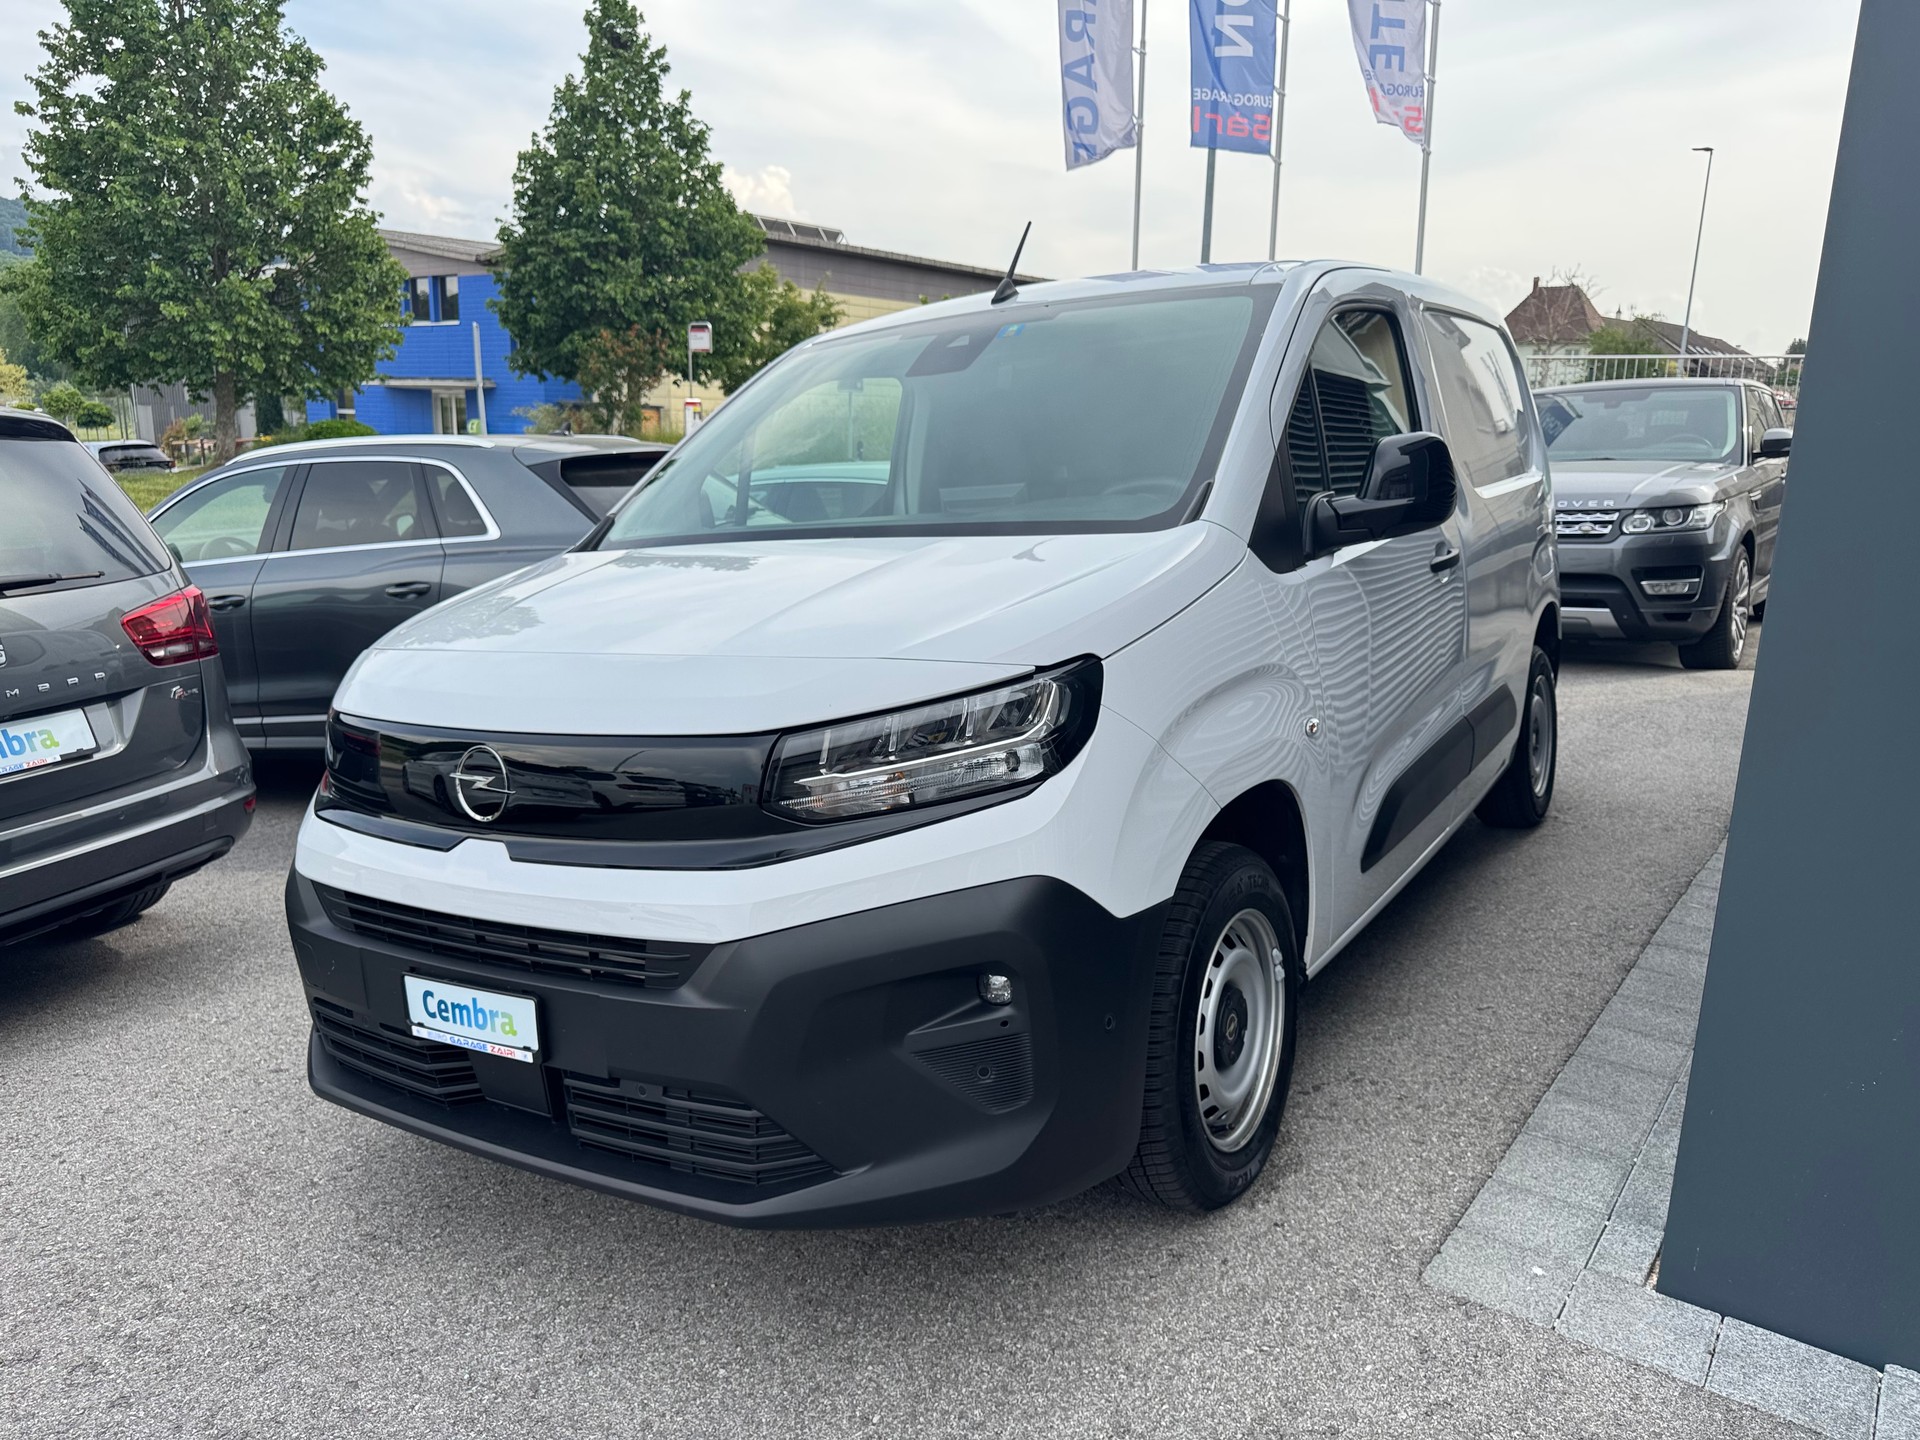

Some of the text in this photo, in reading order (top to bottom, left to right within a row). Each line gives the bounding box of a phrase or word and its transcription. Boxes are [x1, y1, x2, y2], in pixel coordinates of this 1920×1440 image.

[422, 989, 518, 1037] Cembra
[449, 1036, 488, 1052] GARAGE
[490, 1045, 516, 1058] ZAIRI
